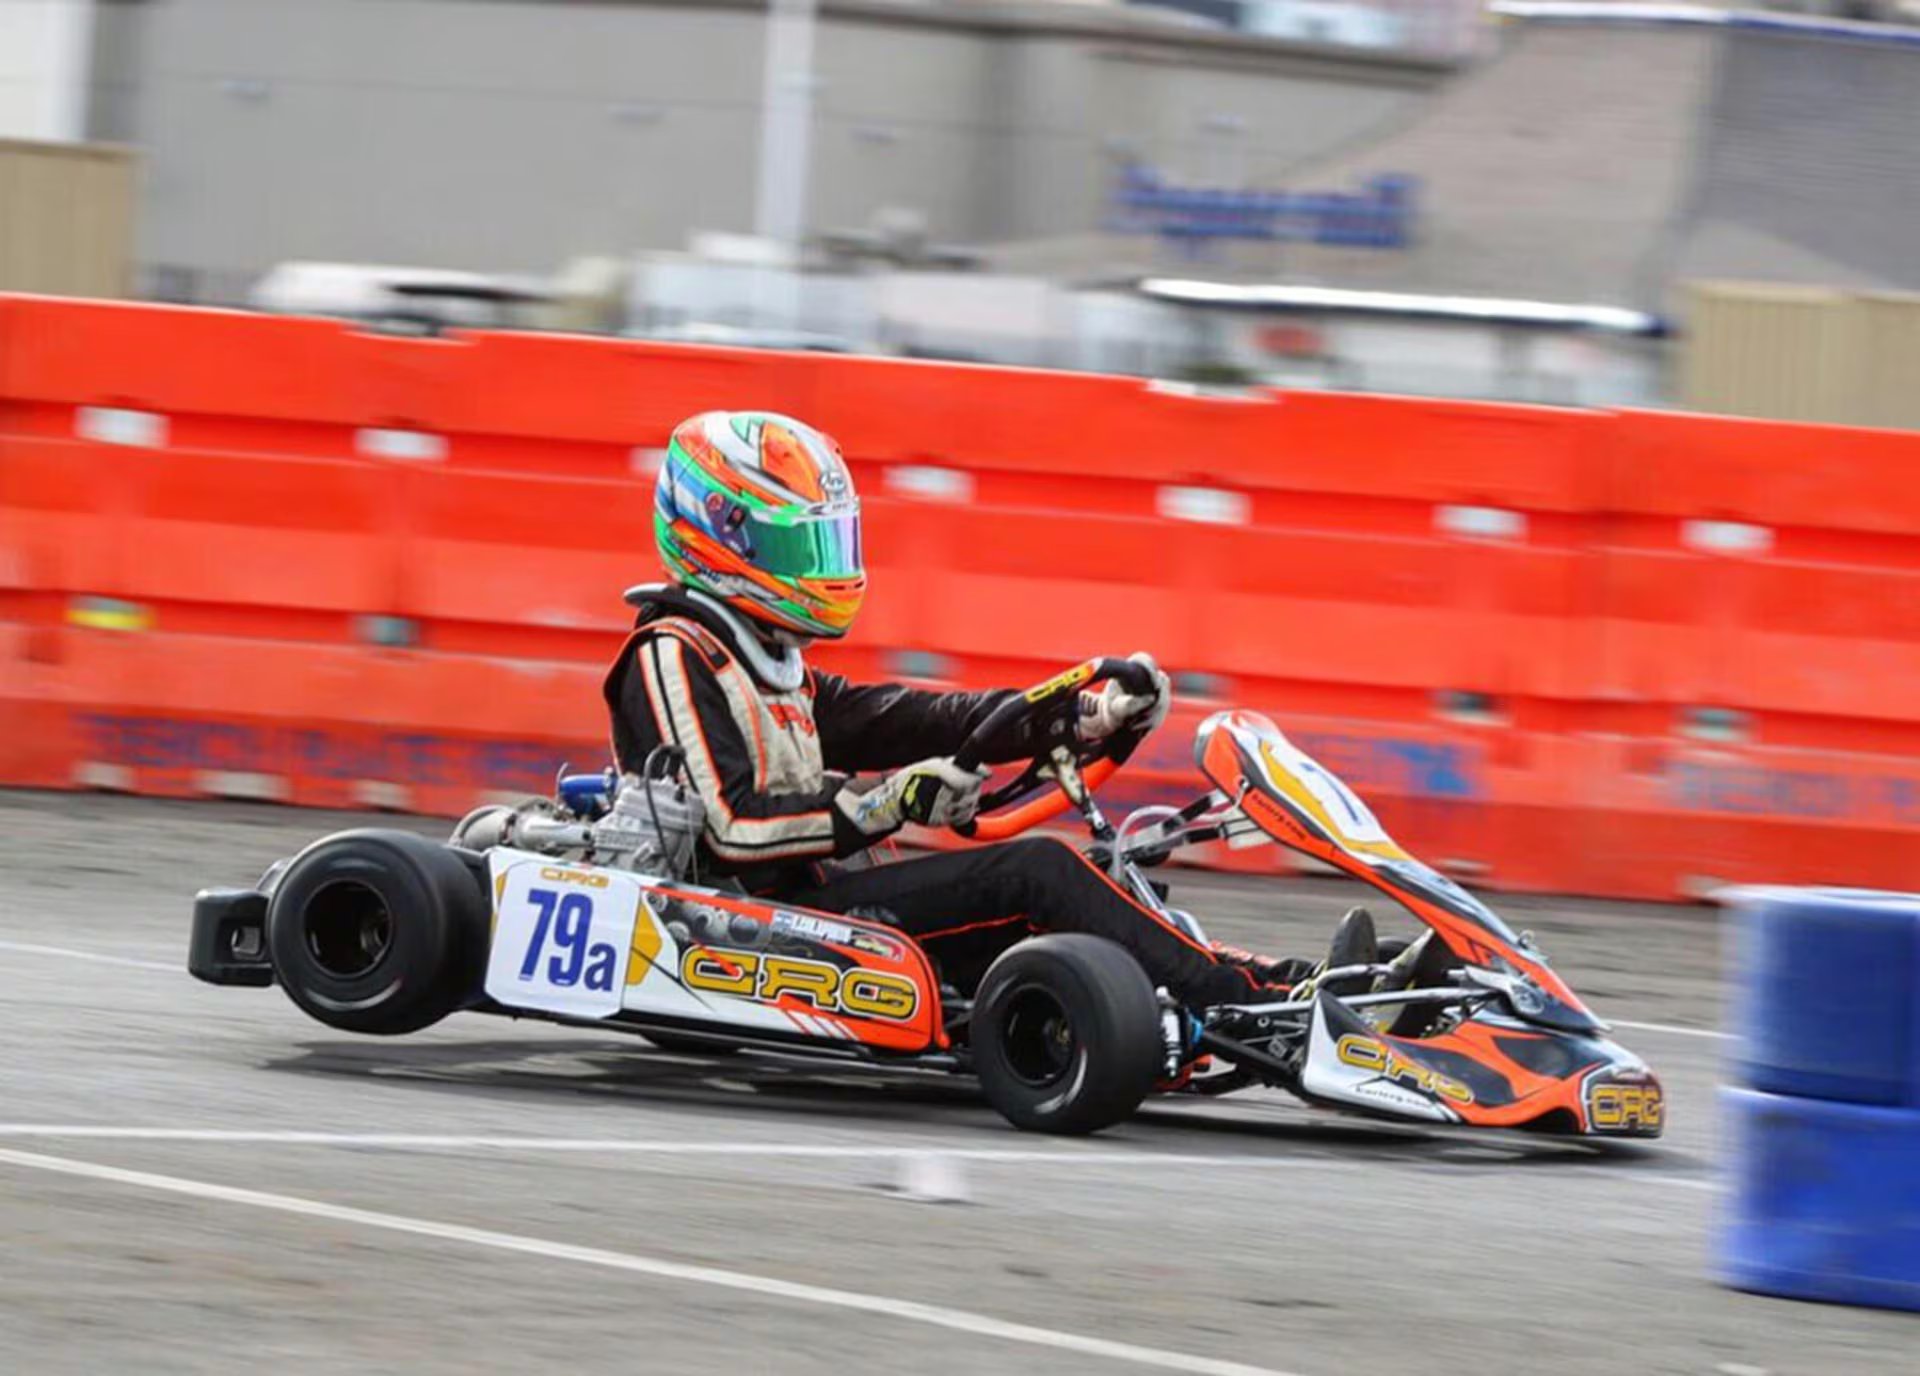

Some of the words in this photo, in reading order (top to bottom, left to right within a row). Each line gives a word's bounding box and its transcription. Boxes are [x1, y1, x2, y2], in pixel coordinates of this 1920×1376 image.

[517, 887, 617, 992] 79a
[682, 945, 919, 1020] CRG
[1337, 1033, 1474, 1105] CRG
[1592, 1085, 1661, 1126] CRG
